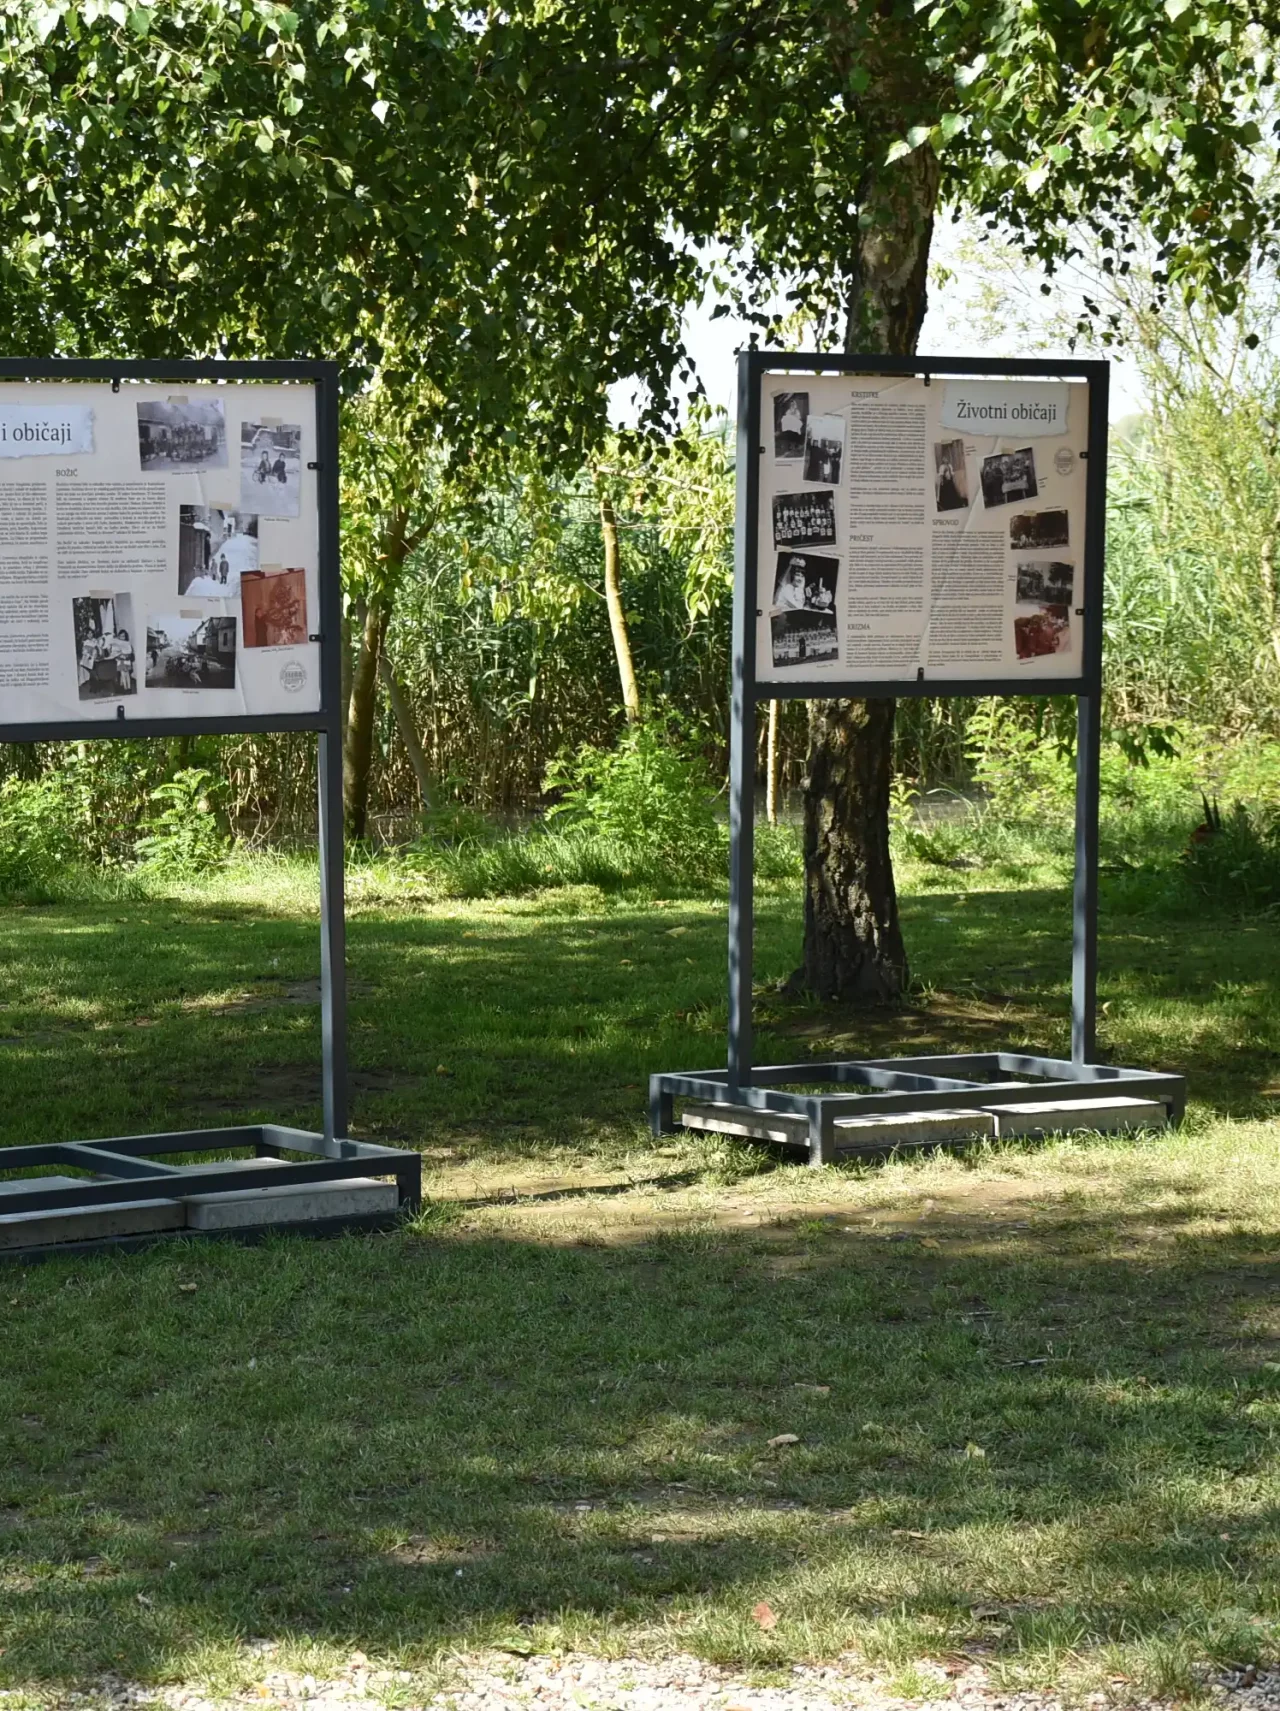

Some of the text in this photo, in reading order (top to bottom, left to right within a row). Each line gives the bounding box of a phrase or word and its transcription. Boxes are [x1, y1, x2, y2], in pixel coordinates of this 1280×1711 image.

[957, 399, 1057, 424] Životni običaji
[12, 421, 72, 446] običaji
